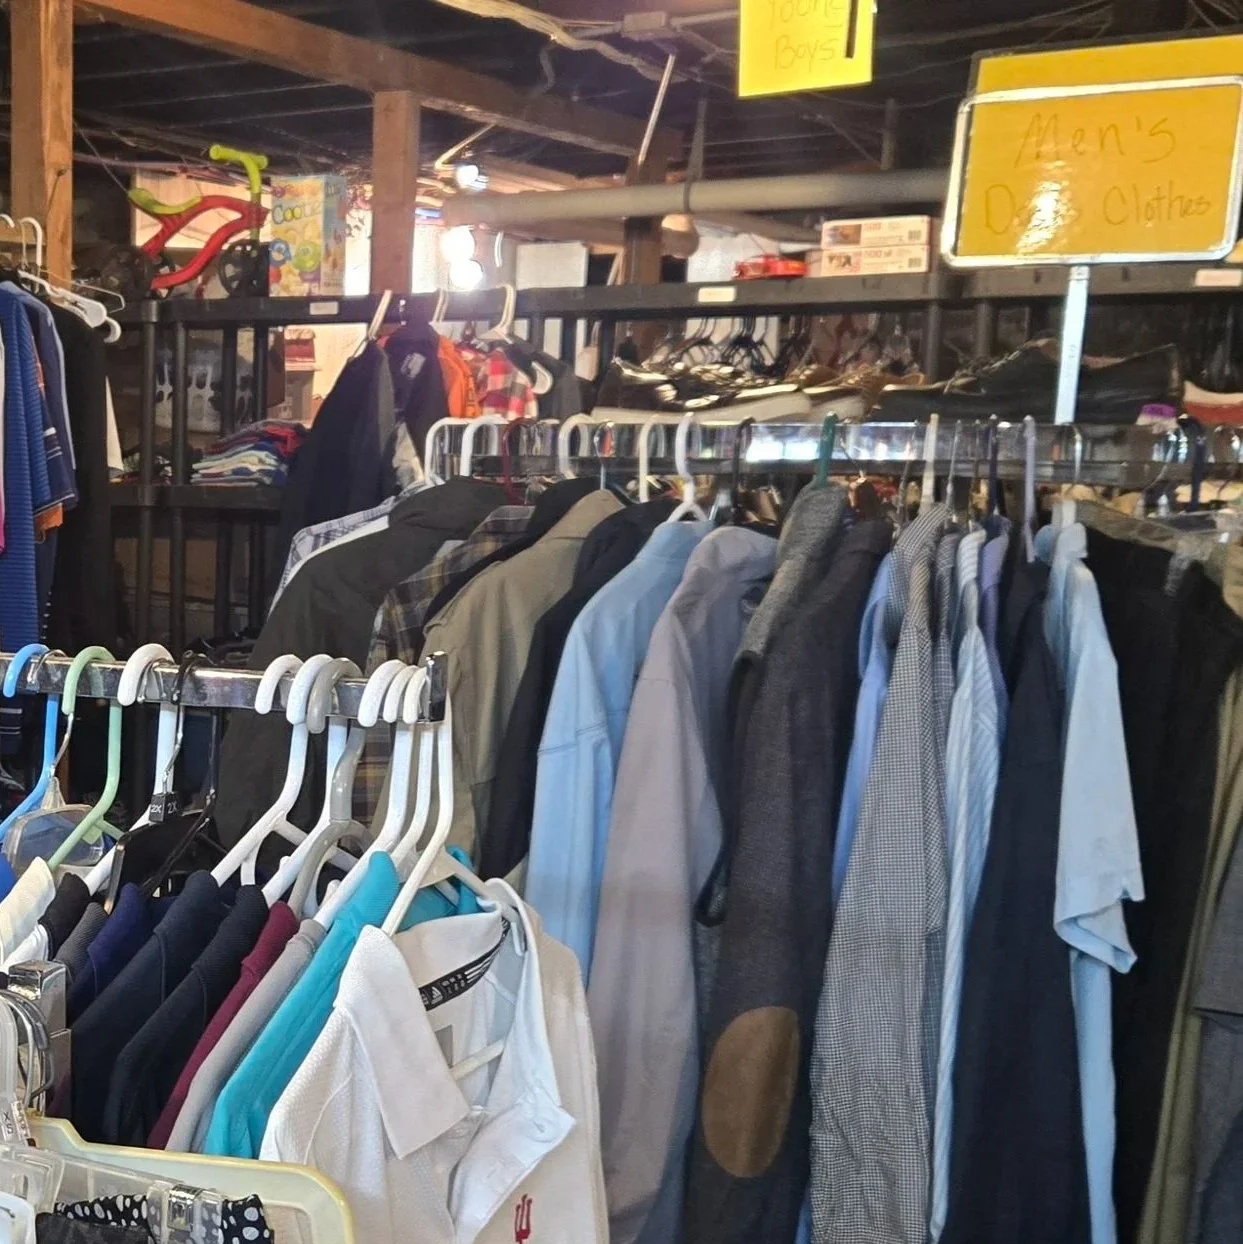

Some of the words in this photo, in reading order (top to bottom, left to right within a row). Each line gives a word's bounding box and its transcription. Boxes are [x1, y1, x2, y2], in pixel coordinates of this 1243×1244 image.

[775, 34, 840, 73] Boys
[1013, 112, 1177, 168] Men's
[1102, 179, 1212, 226] Clothes
[150, 804, 162, 813] 2X
